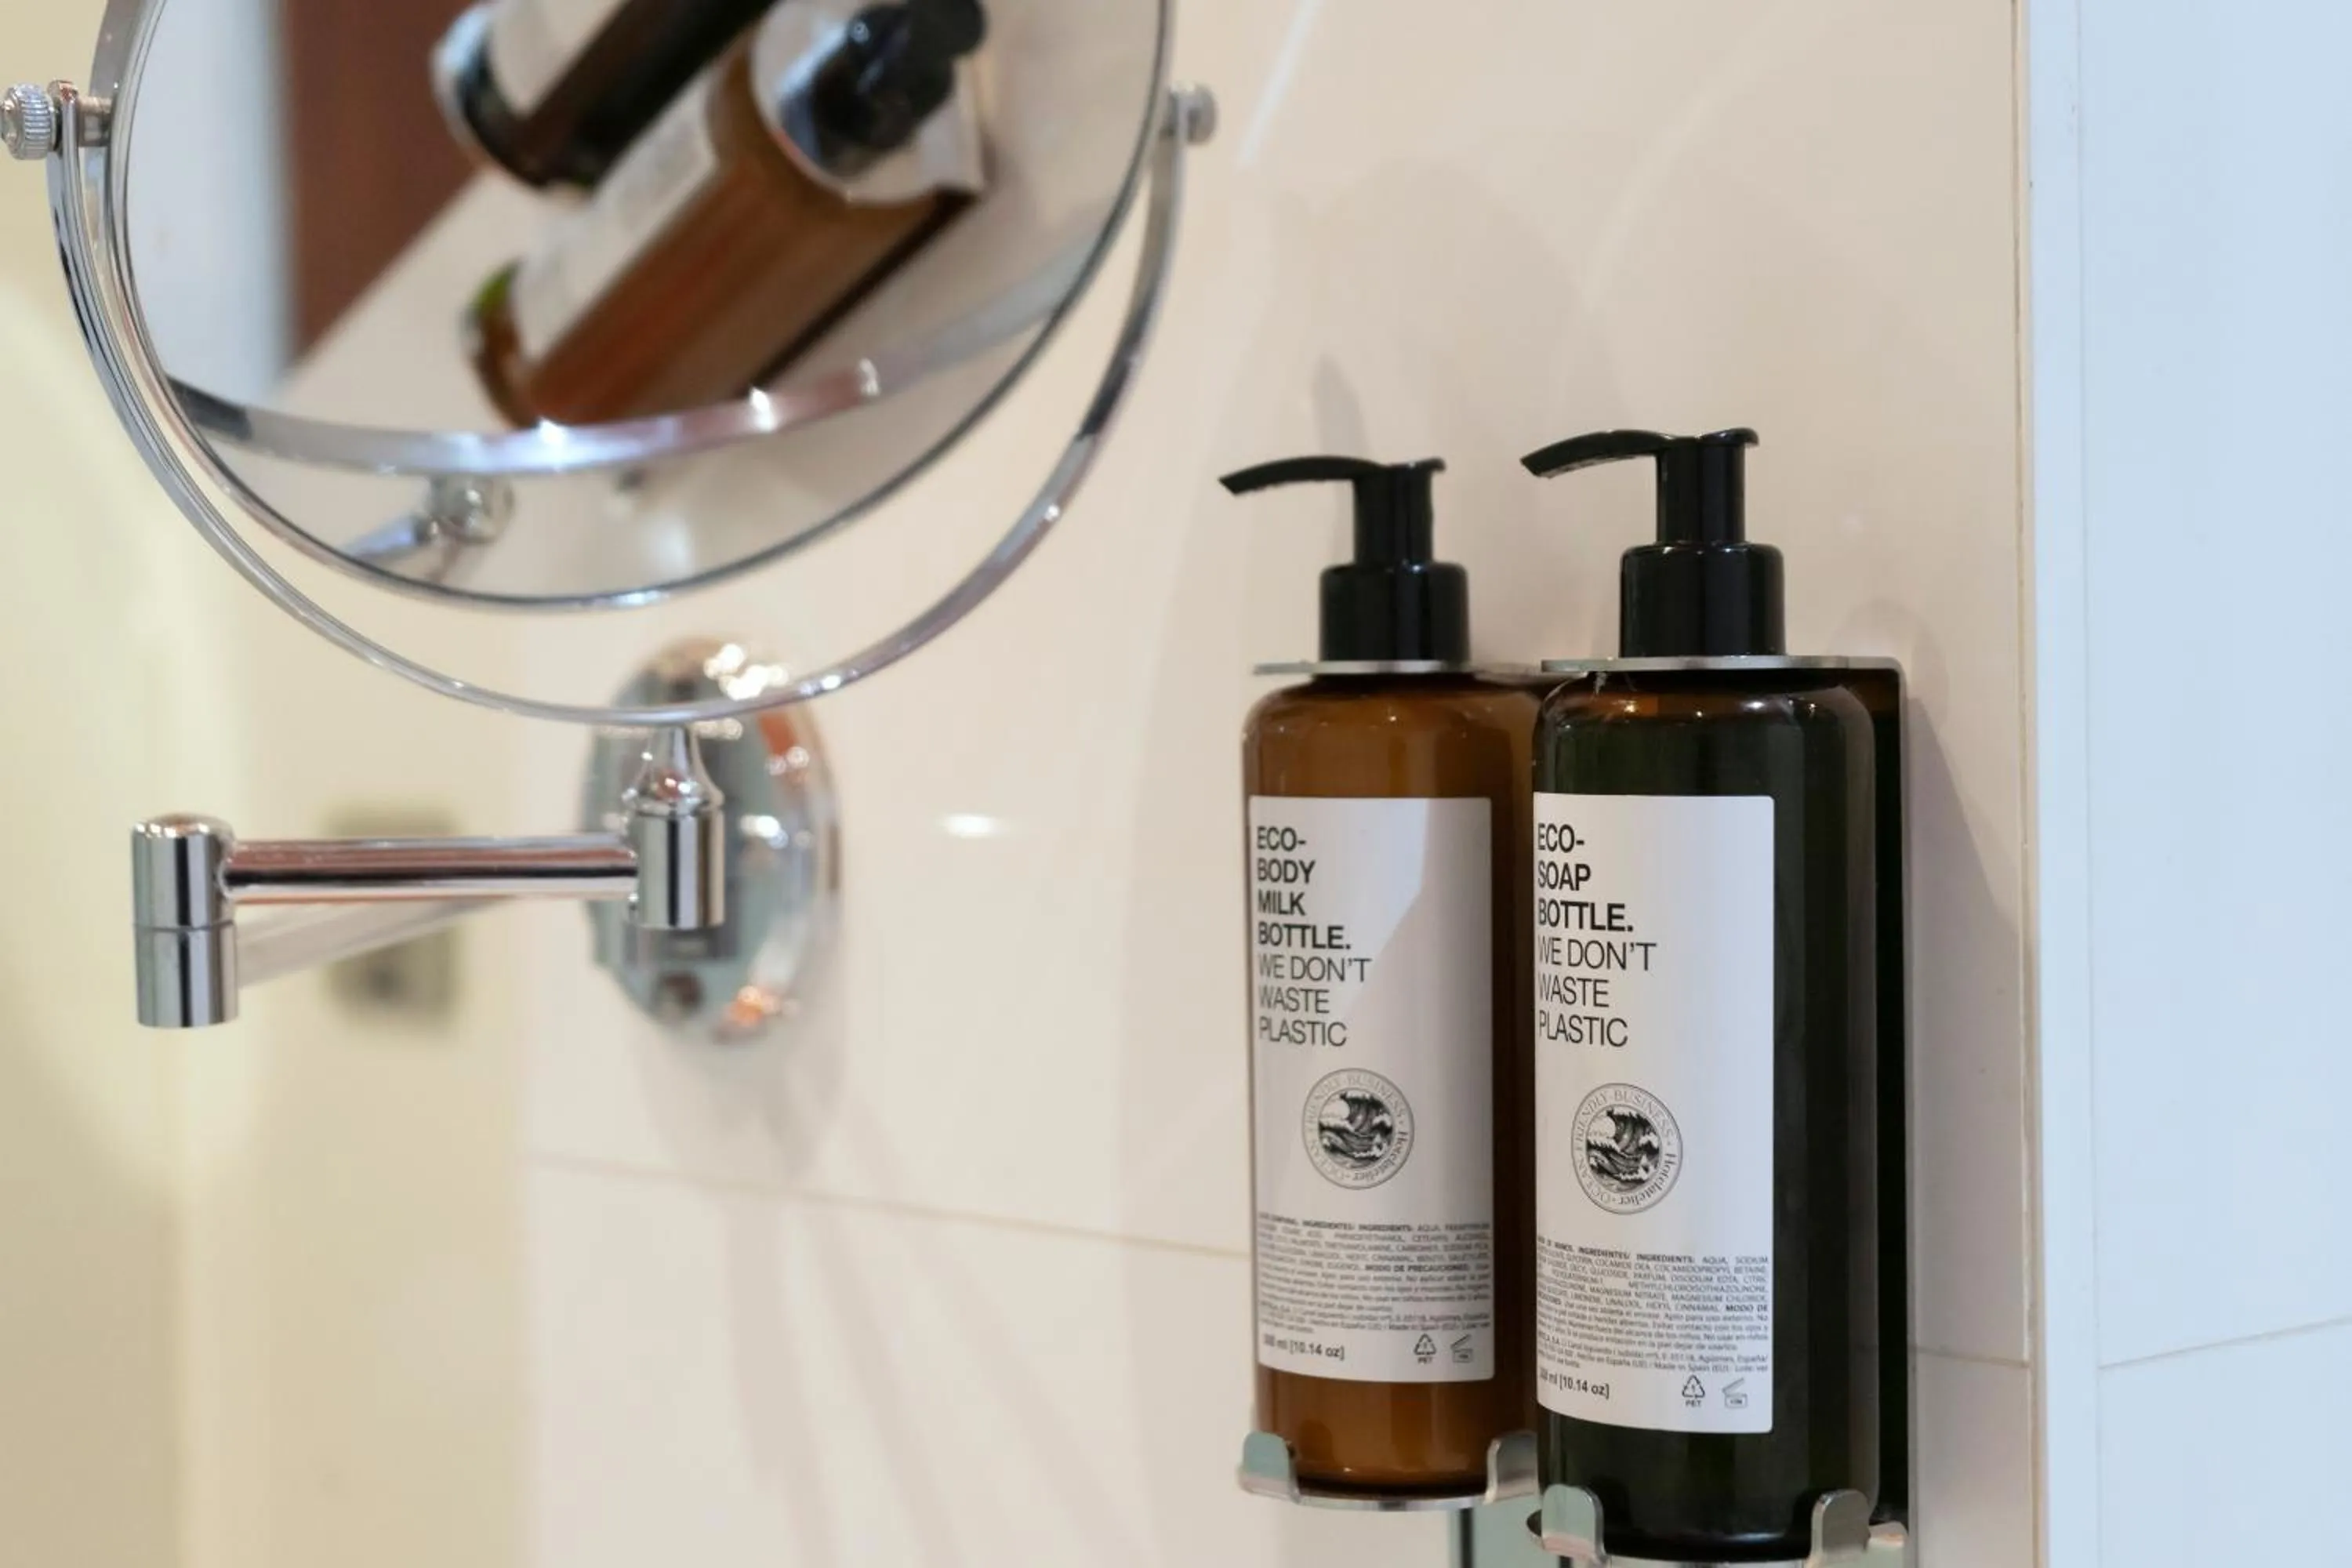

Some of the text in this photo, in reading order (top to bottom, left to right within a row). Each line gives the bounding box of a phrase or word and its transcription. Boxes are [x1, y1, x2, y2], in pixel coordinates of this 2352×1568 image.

[1257, 826, 1307, 852] ECO-
[1537, 823, 1585, 852] ECO-
[1257, 858, 1316, 885] BODY
[1537, 862, 1591, 891] SOAP
[1258, 889, 1306, 916] MILK
[1537, 899, 1634, 933] BOTTLE.
[1258, 922, 1352, 950] BOTTLE.
[1258, 953, 1372, 982] WE DON'T
[1537, 935, 1657, 971] WE DON'T
[1258, 985, 1330, 1014] WASTE
[1537, 971, 1610, 1008] WASTE
[1258, 1016, 1348, 1047] PLASTIC
[1538, 1009, 1628, 1047] PLASTIC
[1325, 1345, 1345, 1362] oz]
[1560, 1374, 1588, 1392] [10.14
